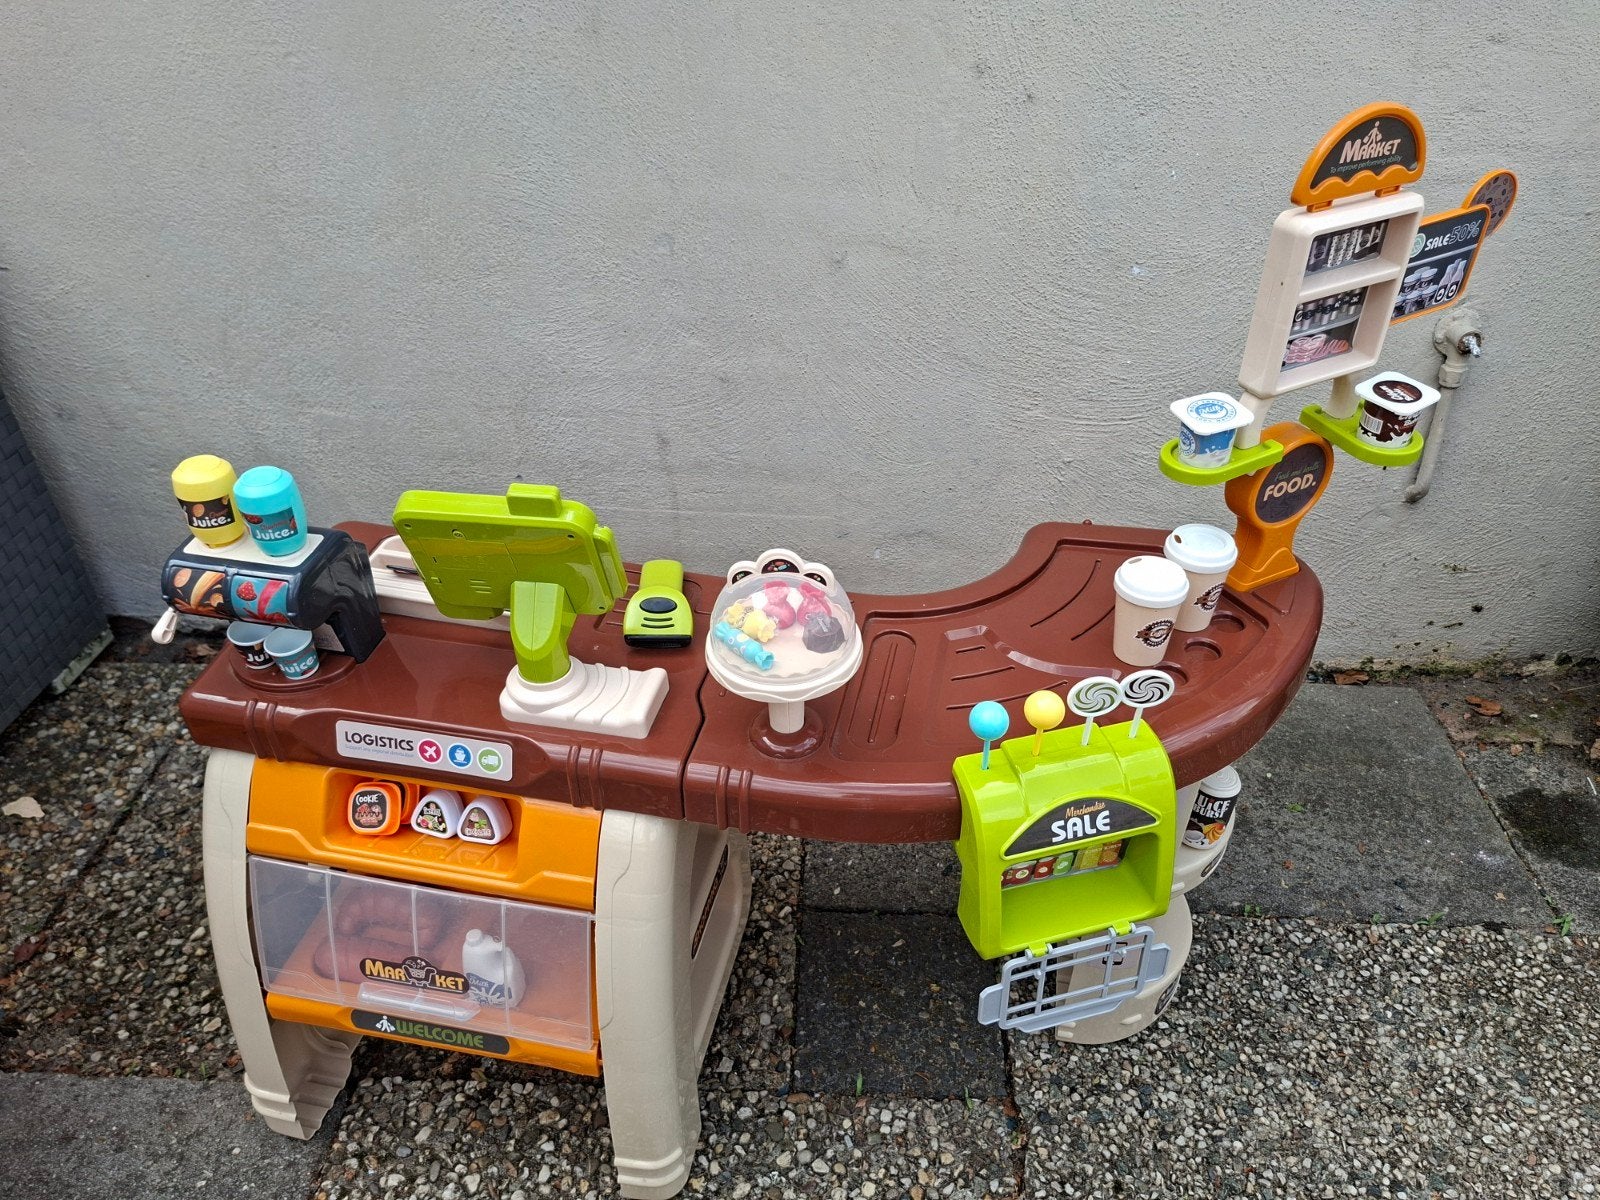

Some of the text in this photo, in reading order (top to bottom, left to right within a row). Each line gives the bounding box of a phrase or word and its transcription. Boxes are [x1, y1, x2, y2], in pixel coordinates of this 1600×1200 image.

[1339, 139, 1402, 164] MARKET
[1424, 219, 1482, 251] SALE 50%
[1263, 473, 1317, 502] FOOD.
[192, 516, 231, 528] Juice.
[255, 528, 295, 541] Juice.
[344, 731, 414, 751] LOGISTICS
[1051, 810, 1111, 843] SALE
[395, 1020, 484, 1048] WELCOME
